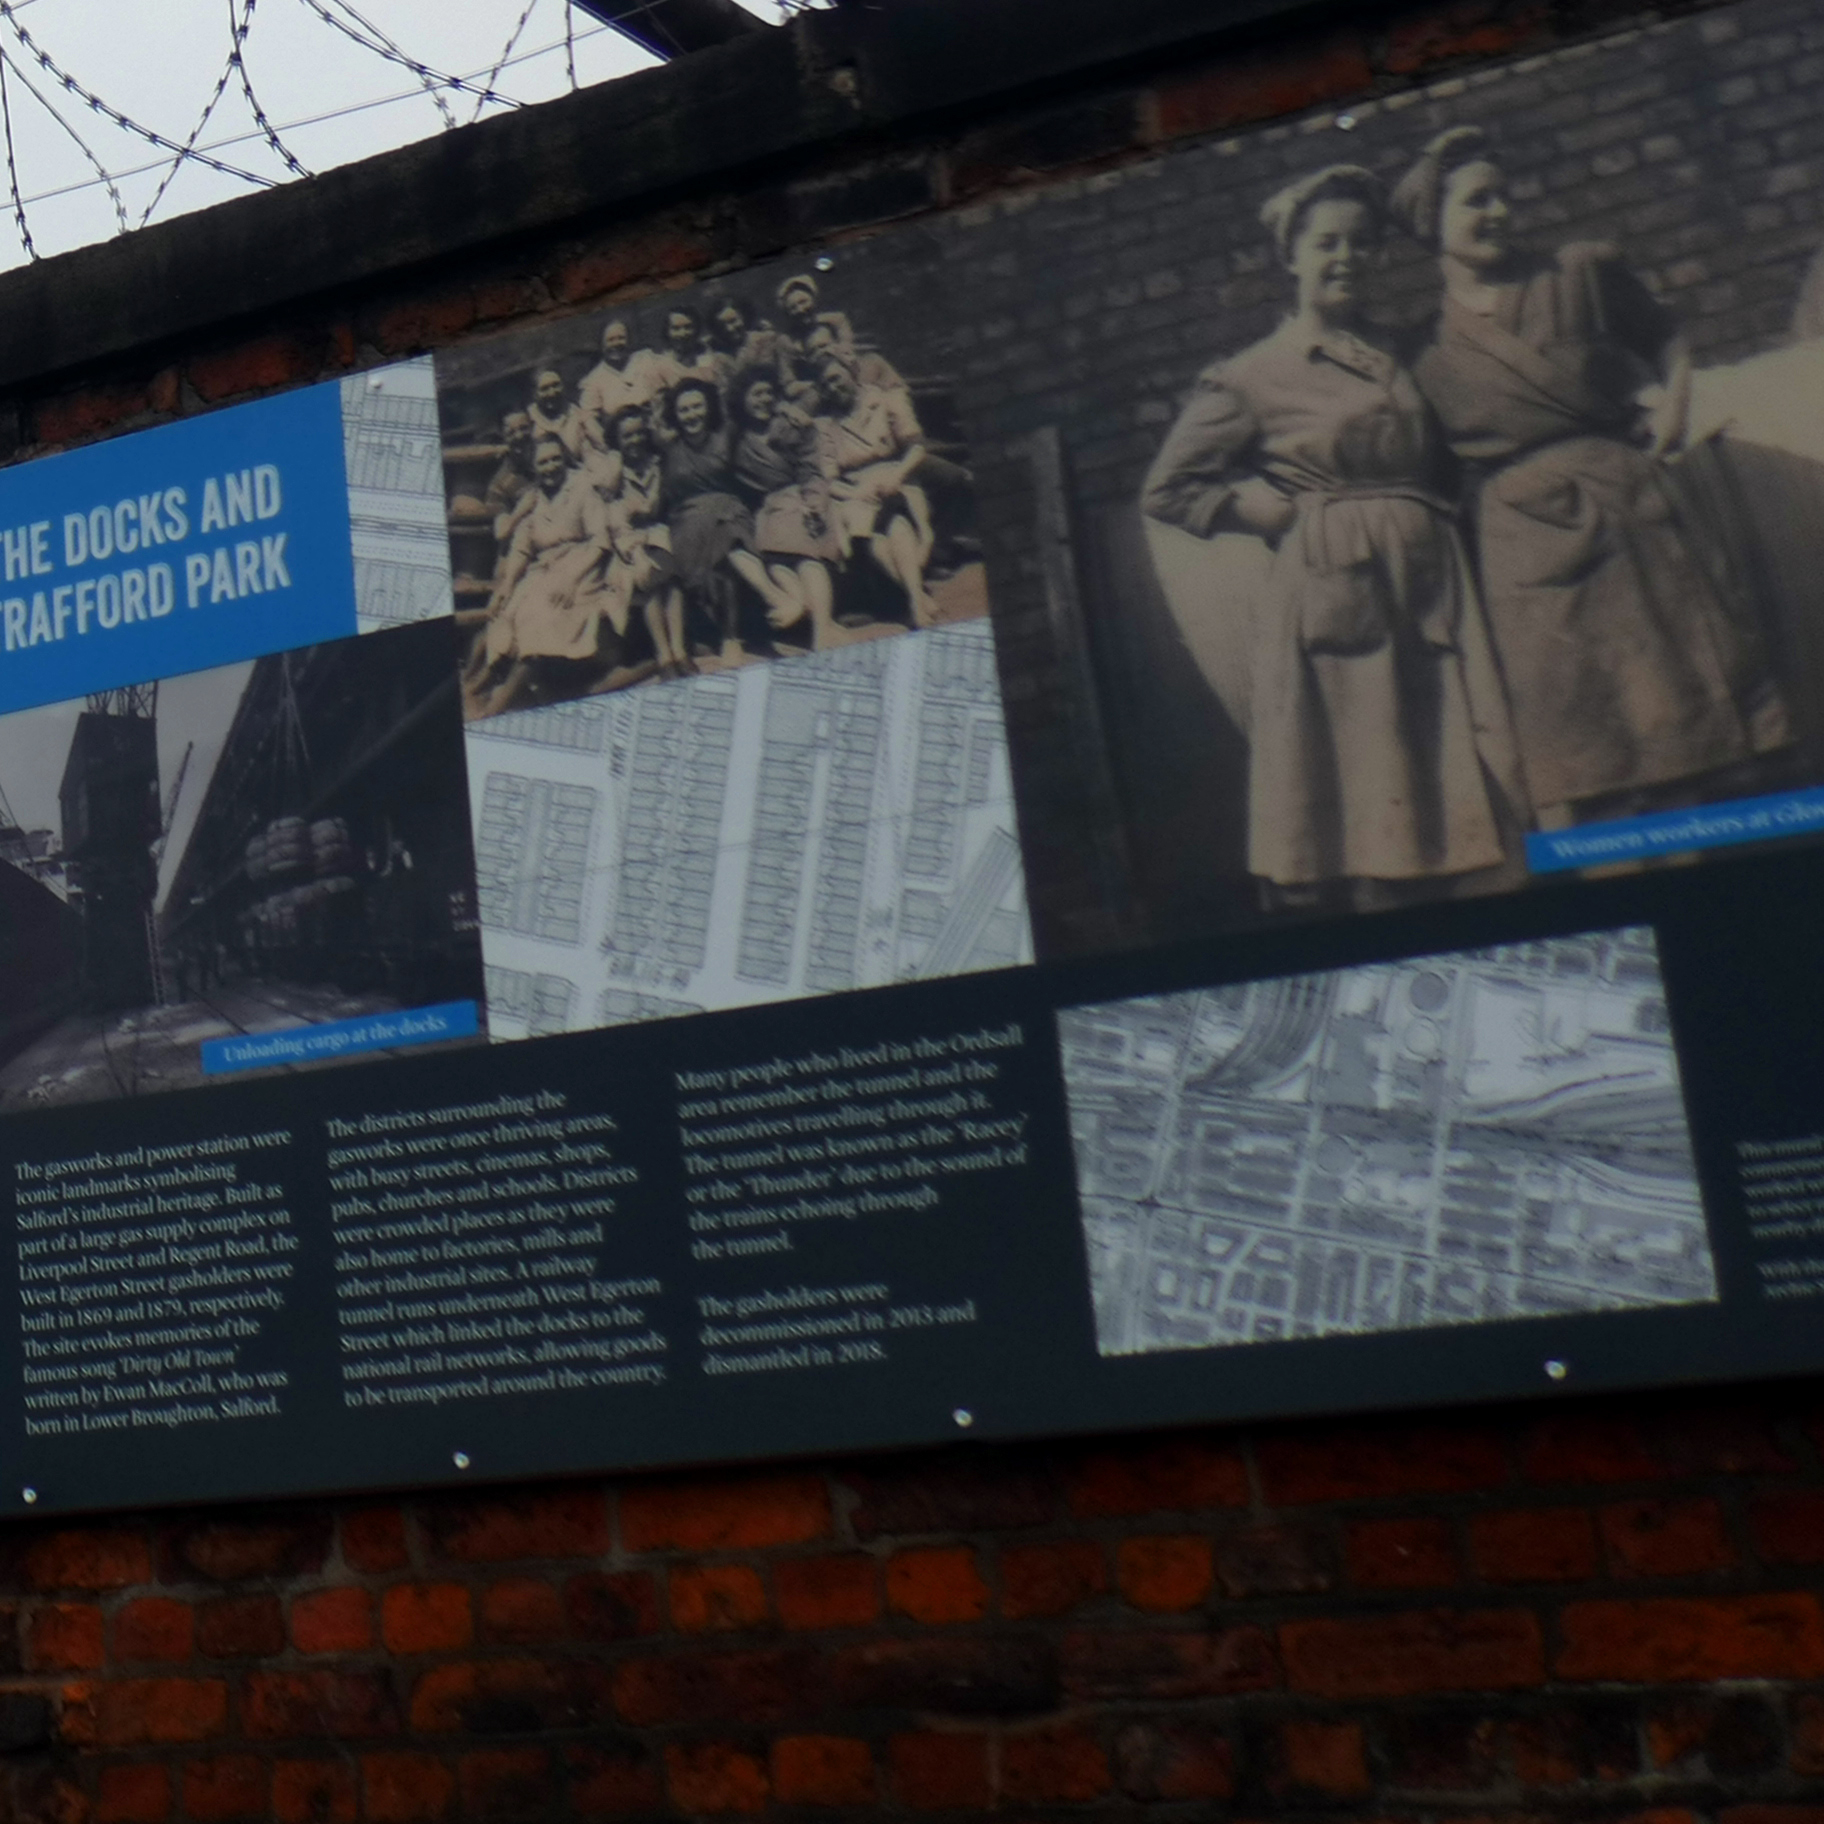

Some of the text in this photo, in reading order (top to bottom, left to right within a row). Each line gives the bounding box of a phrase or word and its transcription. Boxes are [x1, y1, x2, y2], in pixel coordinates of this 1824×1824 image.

[64, 486, 188, 567] DOCKS
[201, 464, 281, 533] AND
[186, 532, 291, 608] PARK
[223, 1015, 447, 1062] Unloading cargo at the docks
[17, 1132, 291, 1180] The gasworks and power station were
[17, 1184, 282, 1230] Salford's industrial heritage. Built as
[20, 1265, 292, 1305] West Egerton Street gasholders were
[21, 1290, 283, 1332] built in 1869 and 1879, respectively.
[24, 1318, 259, 1357] The site evokes memories of the
[25, 1373, 288, 1409] written by Ewan MacColl, who was
